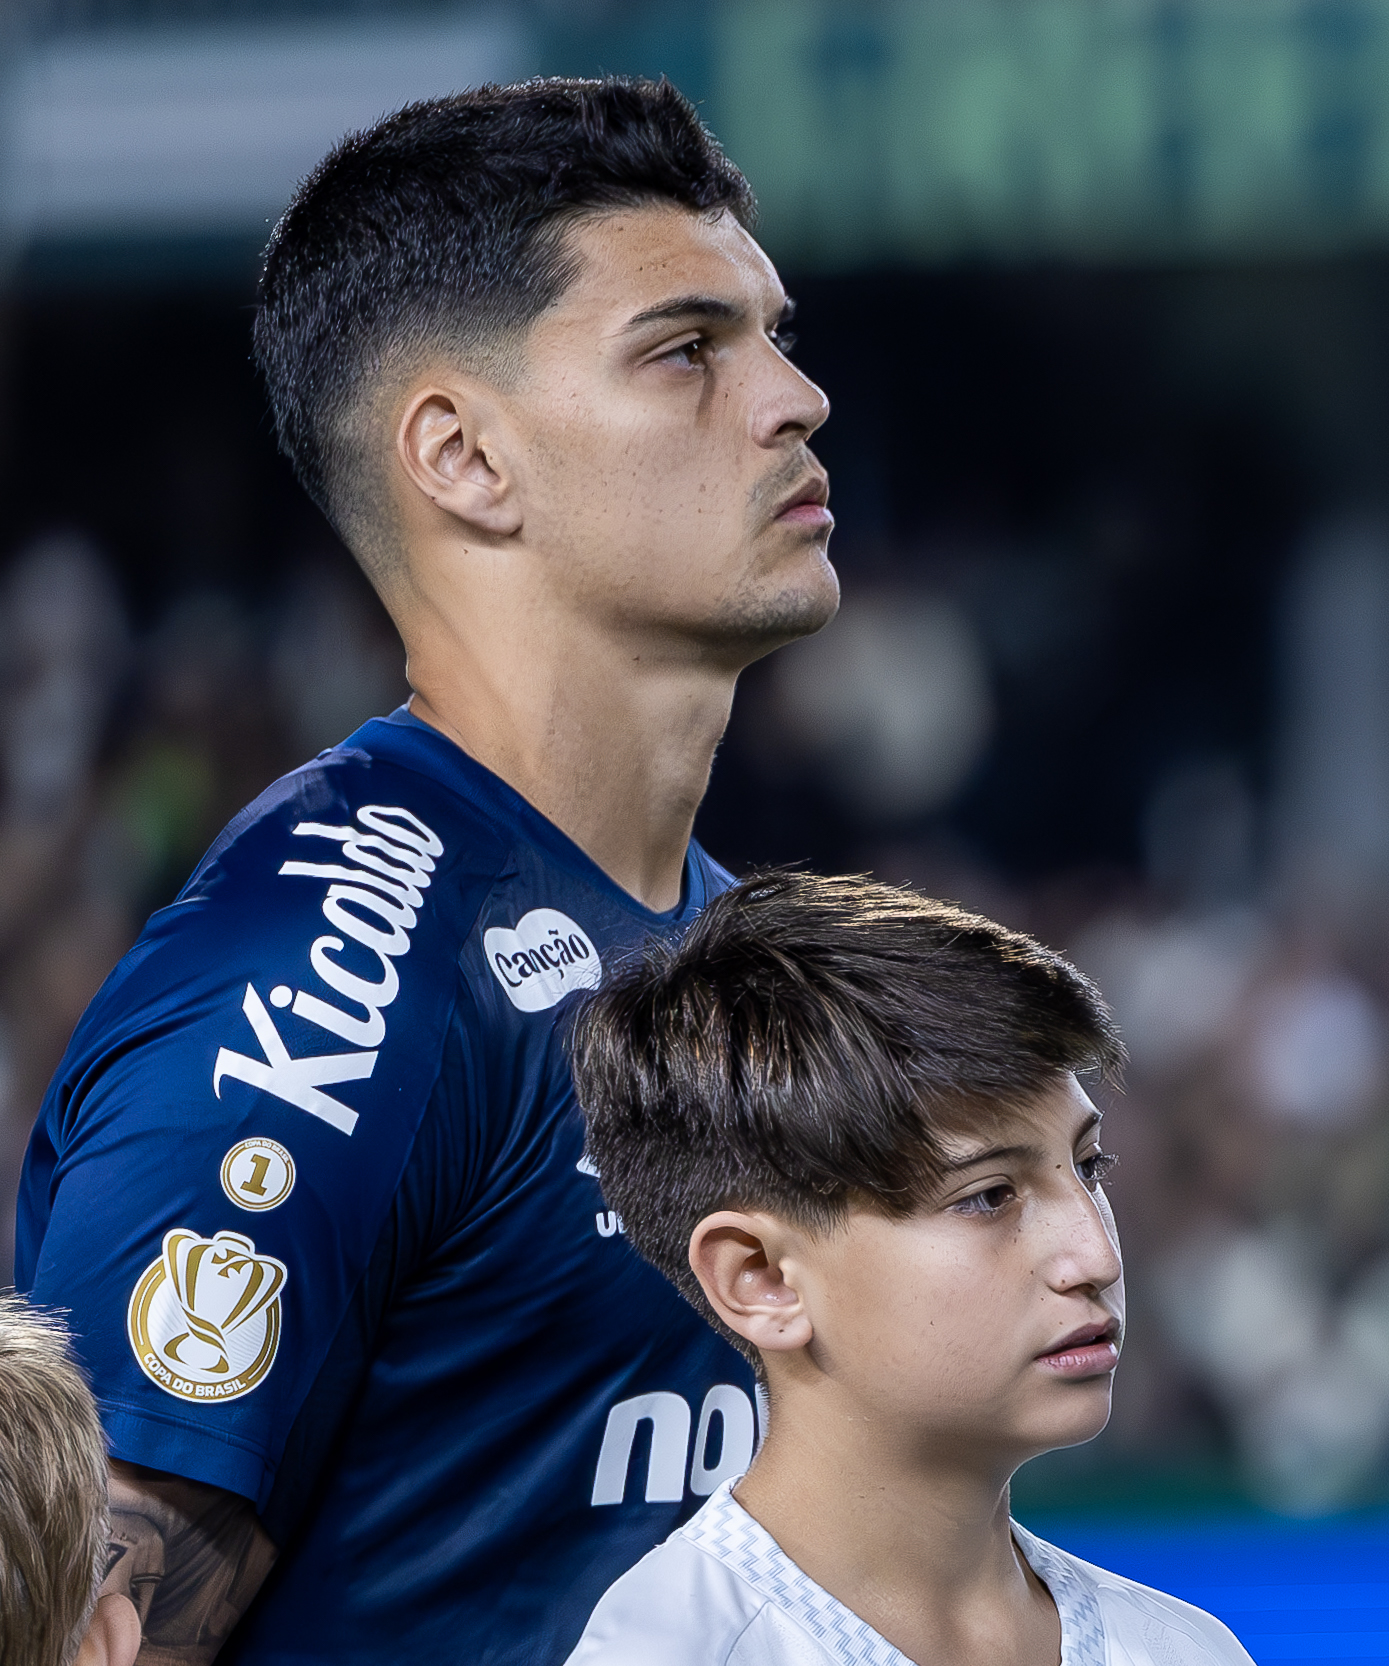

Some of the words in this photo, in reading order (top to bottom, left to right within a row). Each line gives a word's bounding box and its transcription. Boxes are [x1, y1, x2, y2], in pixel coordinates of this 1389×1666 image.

[213, 804, 444, 1136] Kicaldo
[494, 929, 590, 988] Canção
[240, 1153, 271, 1196] 1
[143, 1352, 171, 1386] COPA
[172, 1379, 194, 1394] DO
[195, 1378, 246, 1397] BRASIL
